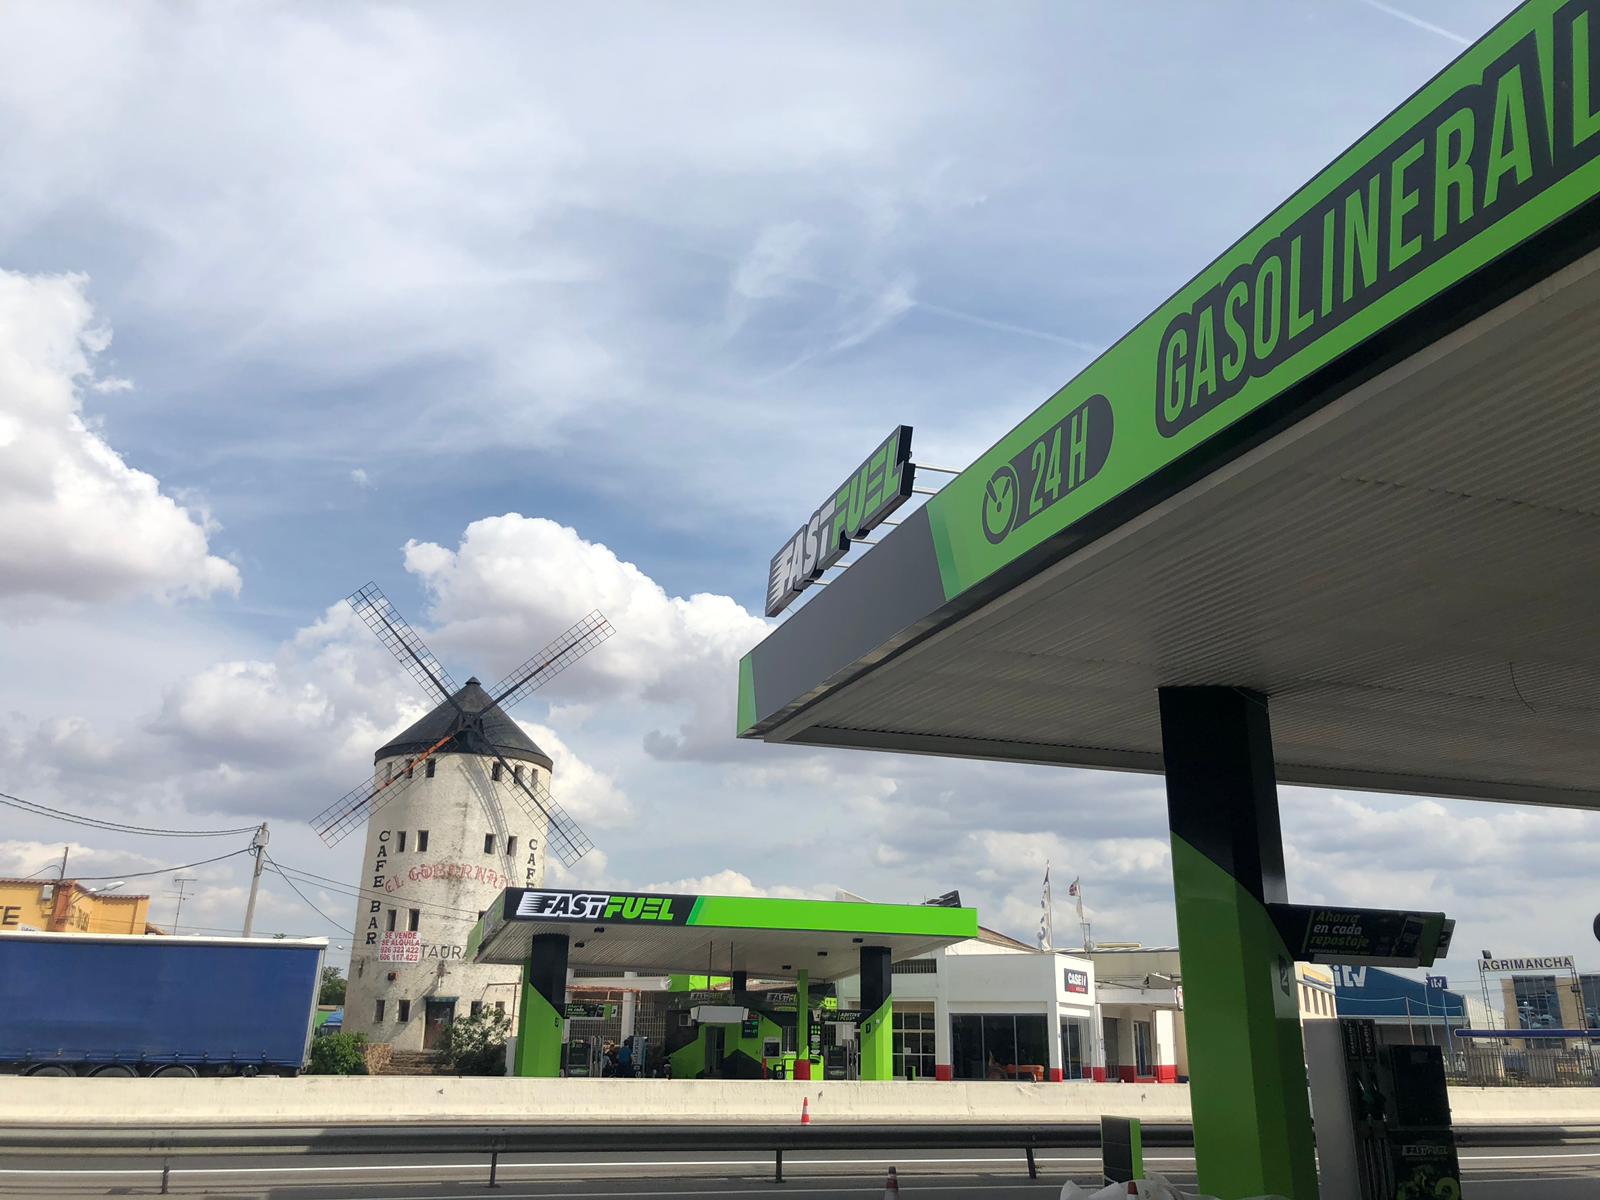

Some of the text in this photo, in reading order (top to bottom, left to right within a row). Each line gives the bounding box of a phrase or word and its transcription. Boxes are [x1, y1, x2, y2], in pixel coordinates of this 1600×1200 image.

[1163, 64, 1533, 423] GASOLINERA
[767, 434, 901, 608] FASTFUEL
[365, 830, 392, 945] CAFE BAR
[516, 891, 674, 921] FASTFUEL
[1315, 911, 1361, 924] Ahorra
[385, 931, 417, 940] SE VENDE
[1313, 923, 1363, 936] en cada
[391, 938, 420, 947] ALQUILA
[421, 944, 467, 960] TAUR
[1482, 956, 1573, 971] AGRIMANCHA
[1281, 967, 1289, 986] 2
